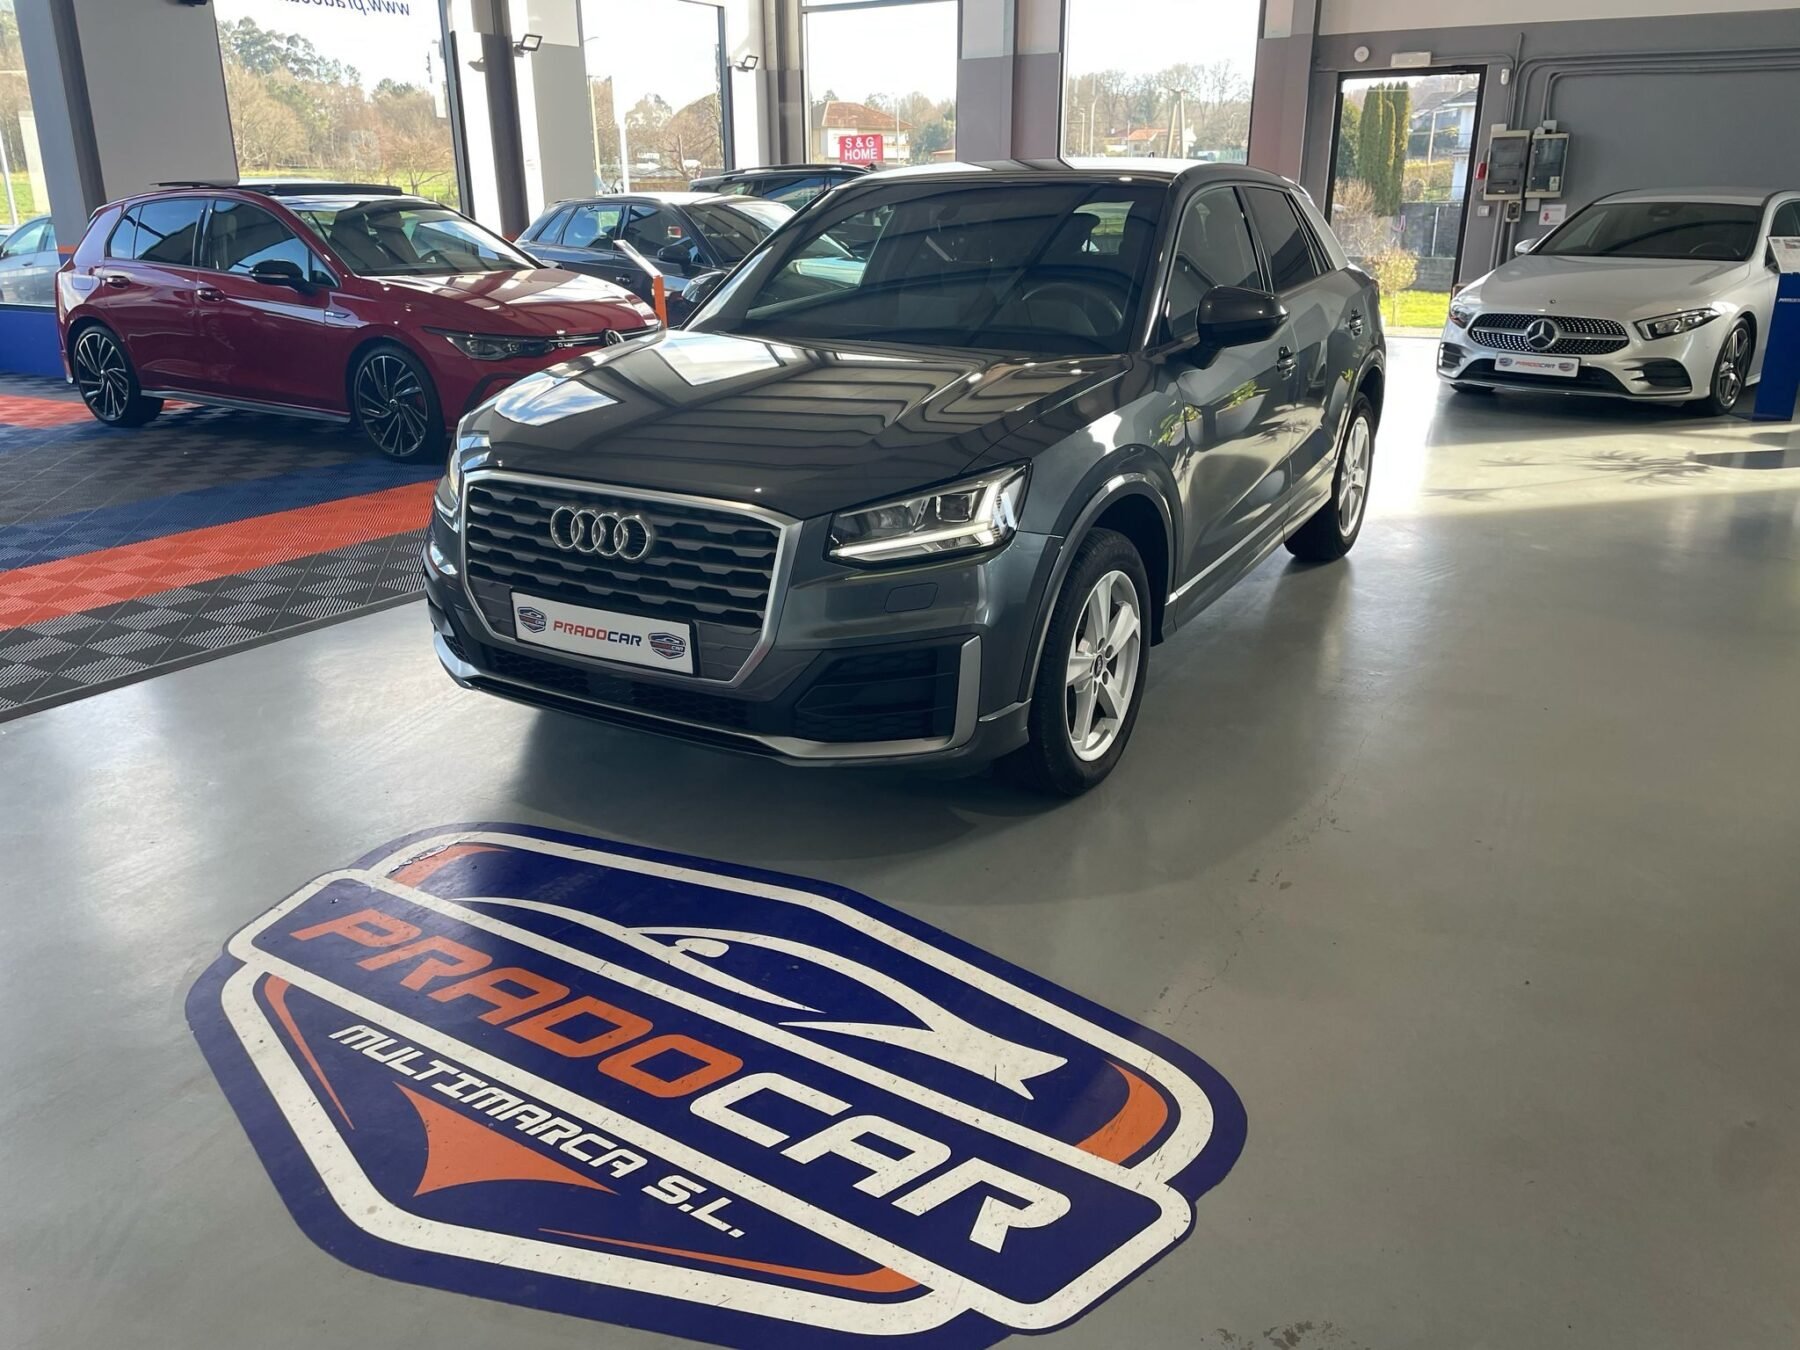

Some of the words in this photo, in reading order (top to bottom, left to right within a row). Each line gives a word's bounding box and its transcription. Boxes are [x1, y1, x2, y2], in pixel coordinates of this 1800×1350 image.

[844, 148, 878, 160] HOME
[845, 138, 853, 149] S
[855, 137, 864, 148] &
[866, 136, 875, 148] G
[553, 620, 642, 646] PRADOCAR
[290, 908, 1072, 1254] PRADOCAR
[328, 1025, 648, 1179] MULTIMARCA
[641, 1174, 746, 1239] S.L.
